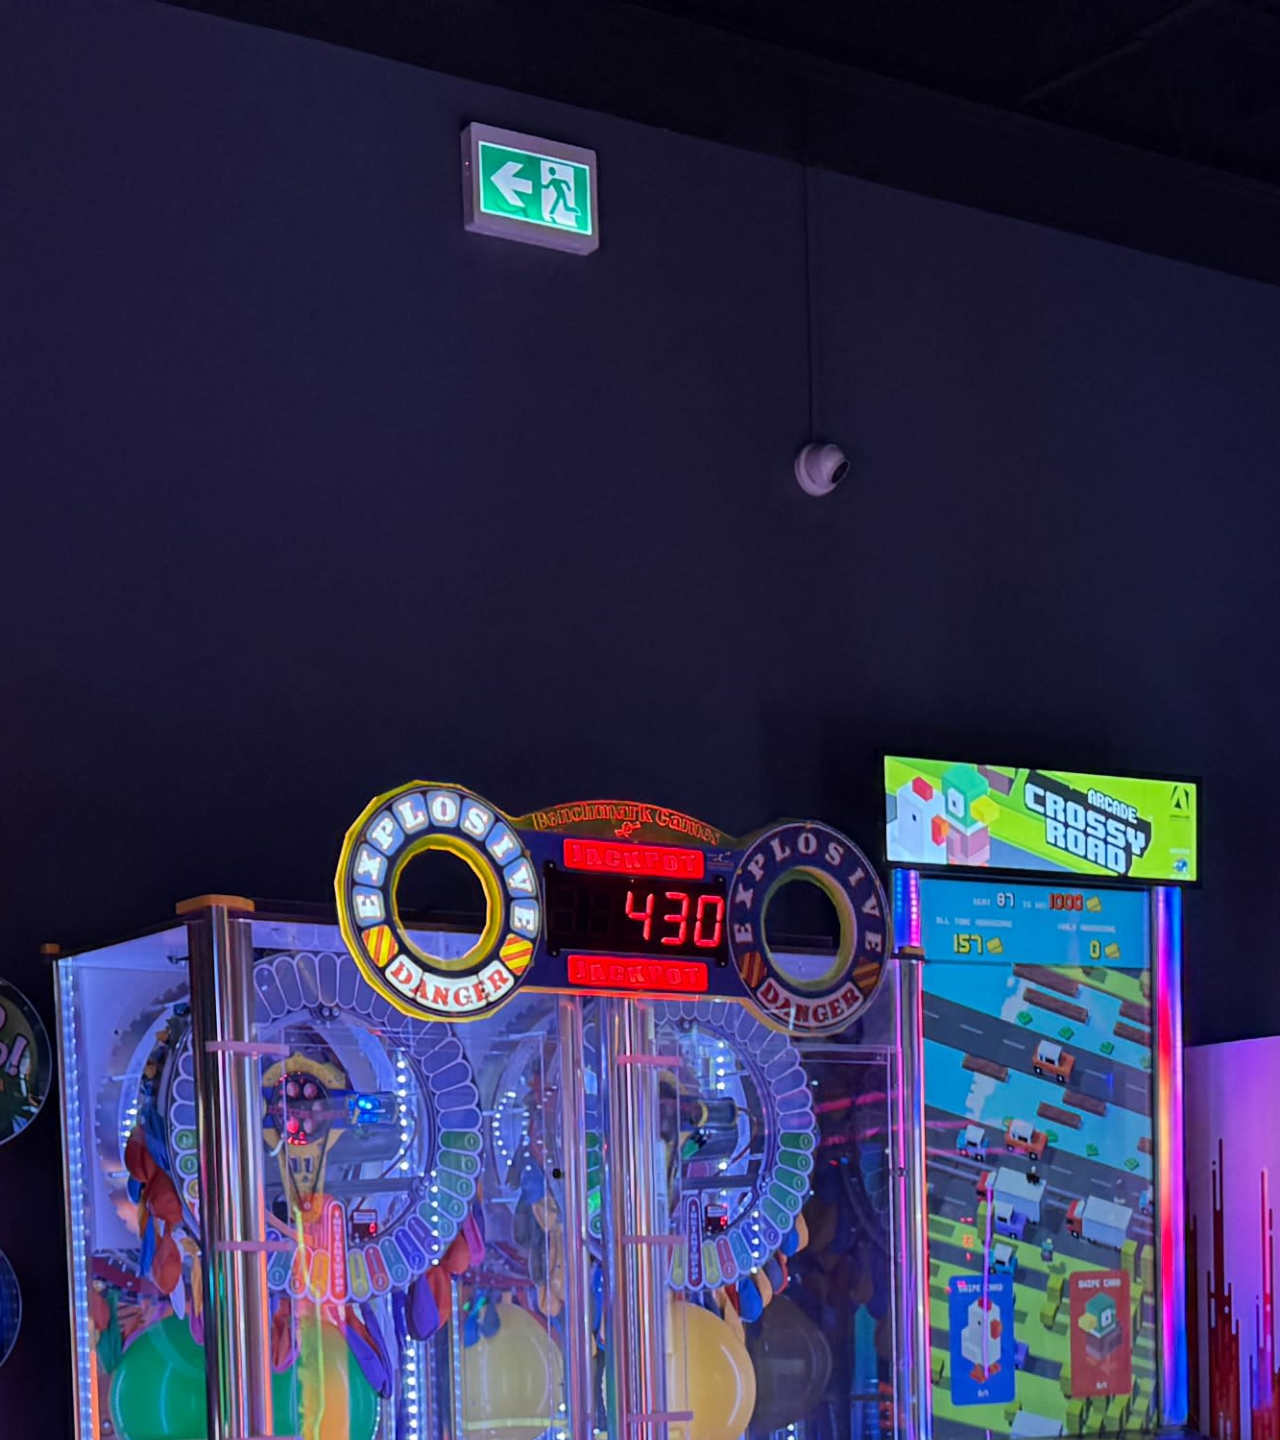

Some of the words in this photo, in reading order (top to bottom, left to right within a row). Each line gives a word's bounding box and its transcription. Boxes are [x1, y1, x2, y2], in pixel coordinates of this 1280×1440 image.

[532, 803, 653, 830] Benchmark
[1025, 783, 1146, 855] CROSSY
[1088, 789, 1137, 823] ARCADE
[354, 791, 538, 934] EXPLOSIVE
[572, 844, 696, 872] JACKPOT
[1046, 818, 1126, 874] ROAD
[996, 892, 1015, 908] 87
[625, 890, 726, 949] 430
[954, 934, 983, 954] 157
[1089, 940, 1101, 959] 0
[391, 959, 508, 1007] DANGER
[576, 961, 699, 986] JACKPOT
[762, 979, 859, 1027] DANGER
